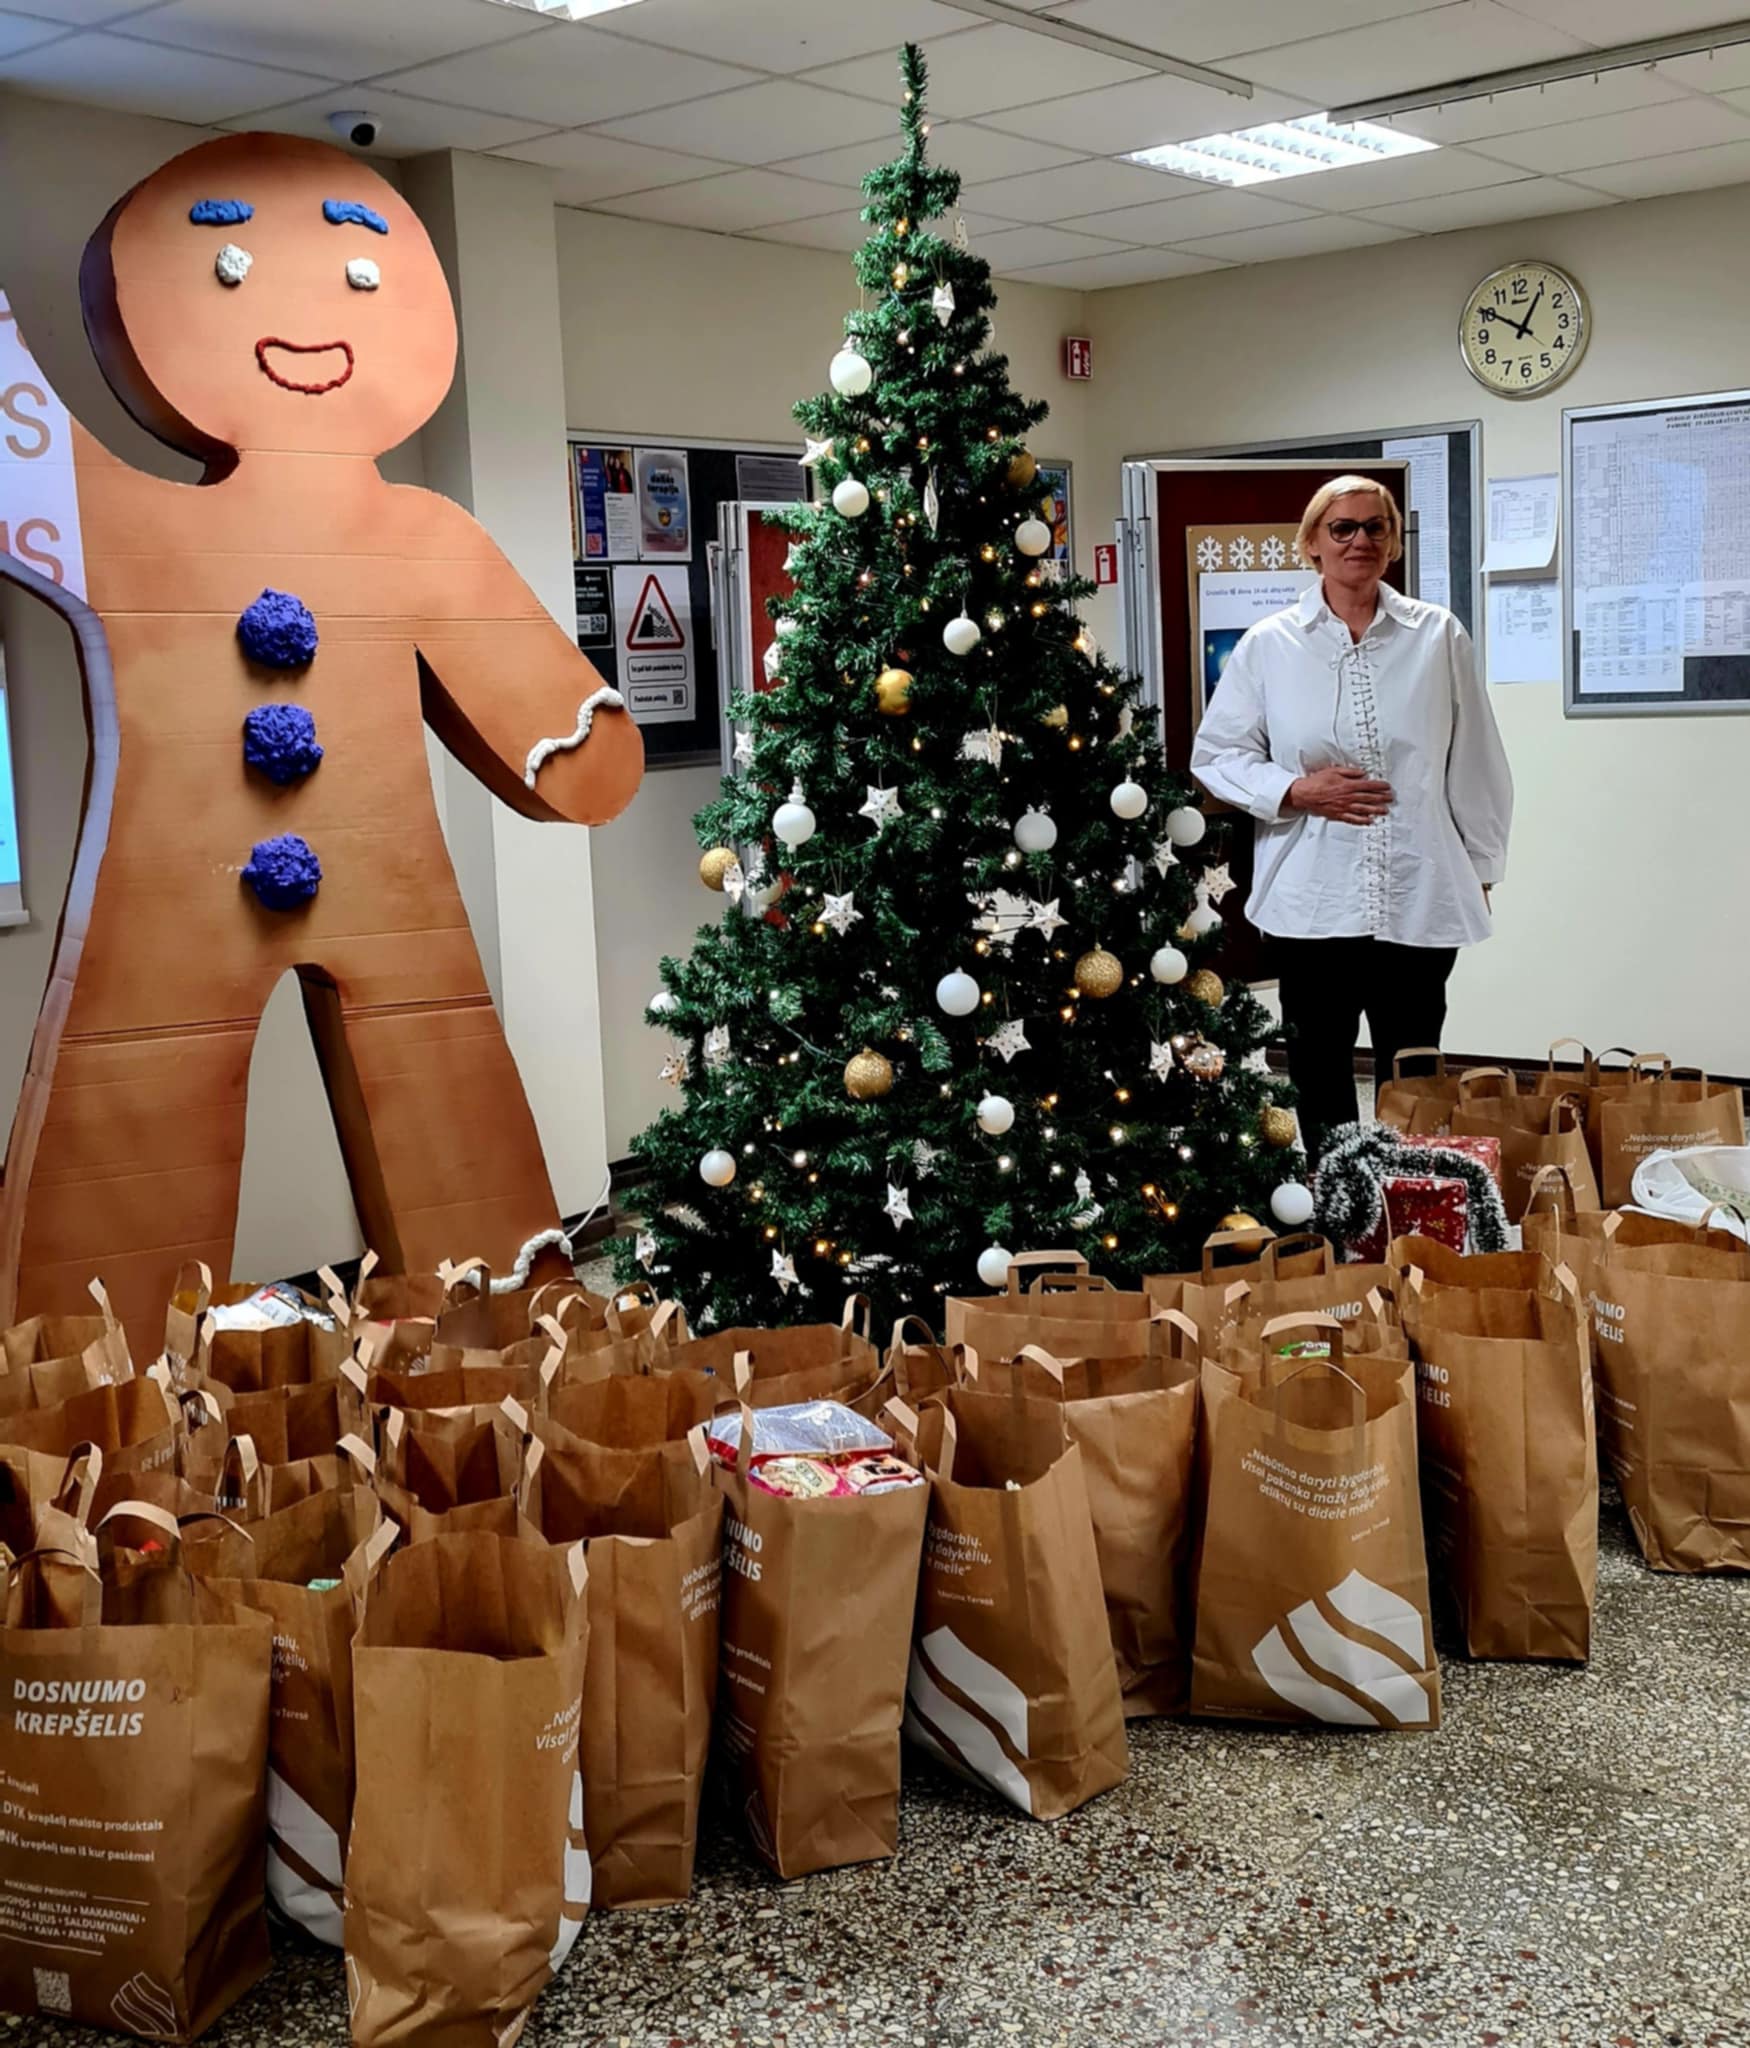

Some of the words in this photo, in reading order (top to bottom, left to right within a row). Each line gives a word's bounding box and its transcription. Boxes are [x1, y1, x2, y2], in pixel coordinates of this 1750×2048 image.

[1511, 278, 1528, 296] 12
[1538, 281, 1545, 296] 1
[1494, 289, 1507, 305] 11
[1552, 293, 1563, 309] 2
[1480, 307, 1497, 323] 10
[1558, 313, 1570, 329] 3
[1478, 329, 1489, 345] 9
[1552, 335, 1565, 350] 4
[1485, 348, 1497, 365] 8
[1540, 352, 1551, 369] 5
[1502, 360, 1513, 376] 7
[1520, 362, 1532, 378] 6
[0, 382, 51, 459] S
[1241, 1458, 1266, 1478] Visai
[1265, 1472, 1310, 1500] pakanka
[1313, 1490, 1348, 1506] mažų
[1299, 1472, 1337, 1490] daryti
[1308, 1505, 1347, 1520] didele
[13, 1678, 147, 1704] DOSNUMO
[15, 1708, 145, 1738] KREPŠELIS
[2, 1799, 26, 1820] DYK
[27, 1810, 67, 1828] krepšelį
[68, 1817, 103, 1829] maisto
[104, 1819, 164, 1832] produktais
[20, 1836, 59, 1854] krepšelį
[60, 1843, 77, 1854] ten
[78, 1844, 87, 1857] iš
[88, 1847, 105, 1858] kur
[38, 1900, 72, 1916] MILTAI
[79, 1905, 141, 1923] MAKARONAI
[21, 1910, 57, 1925] ALIEJUS
[64, 1917, 129, 1935] SALDUMYNAI
[34, 1925, 60, 1937] KAVA
[67, 1930, 106, 1944] ARBATA
